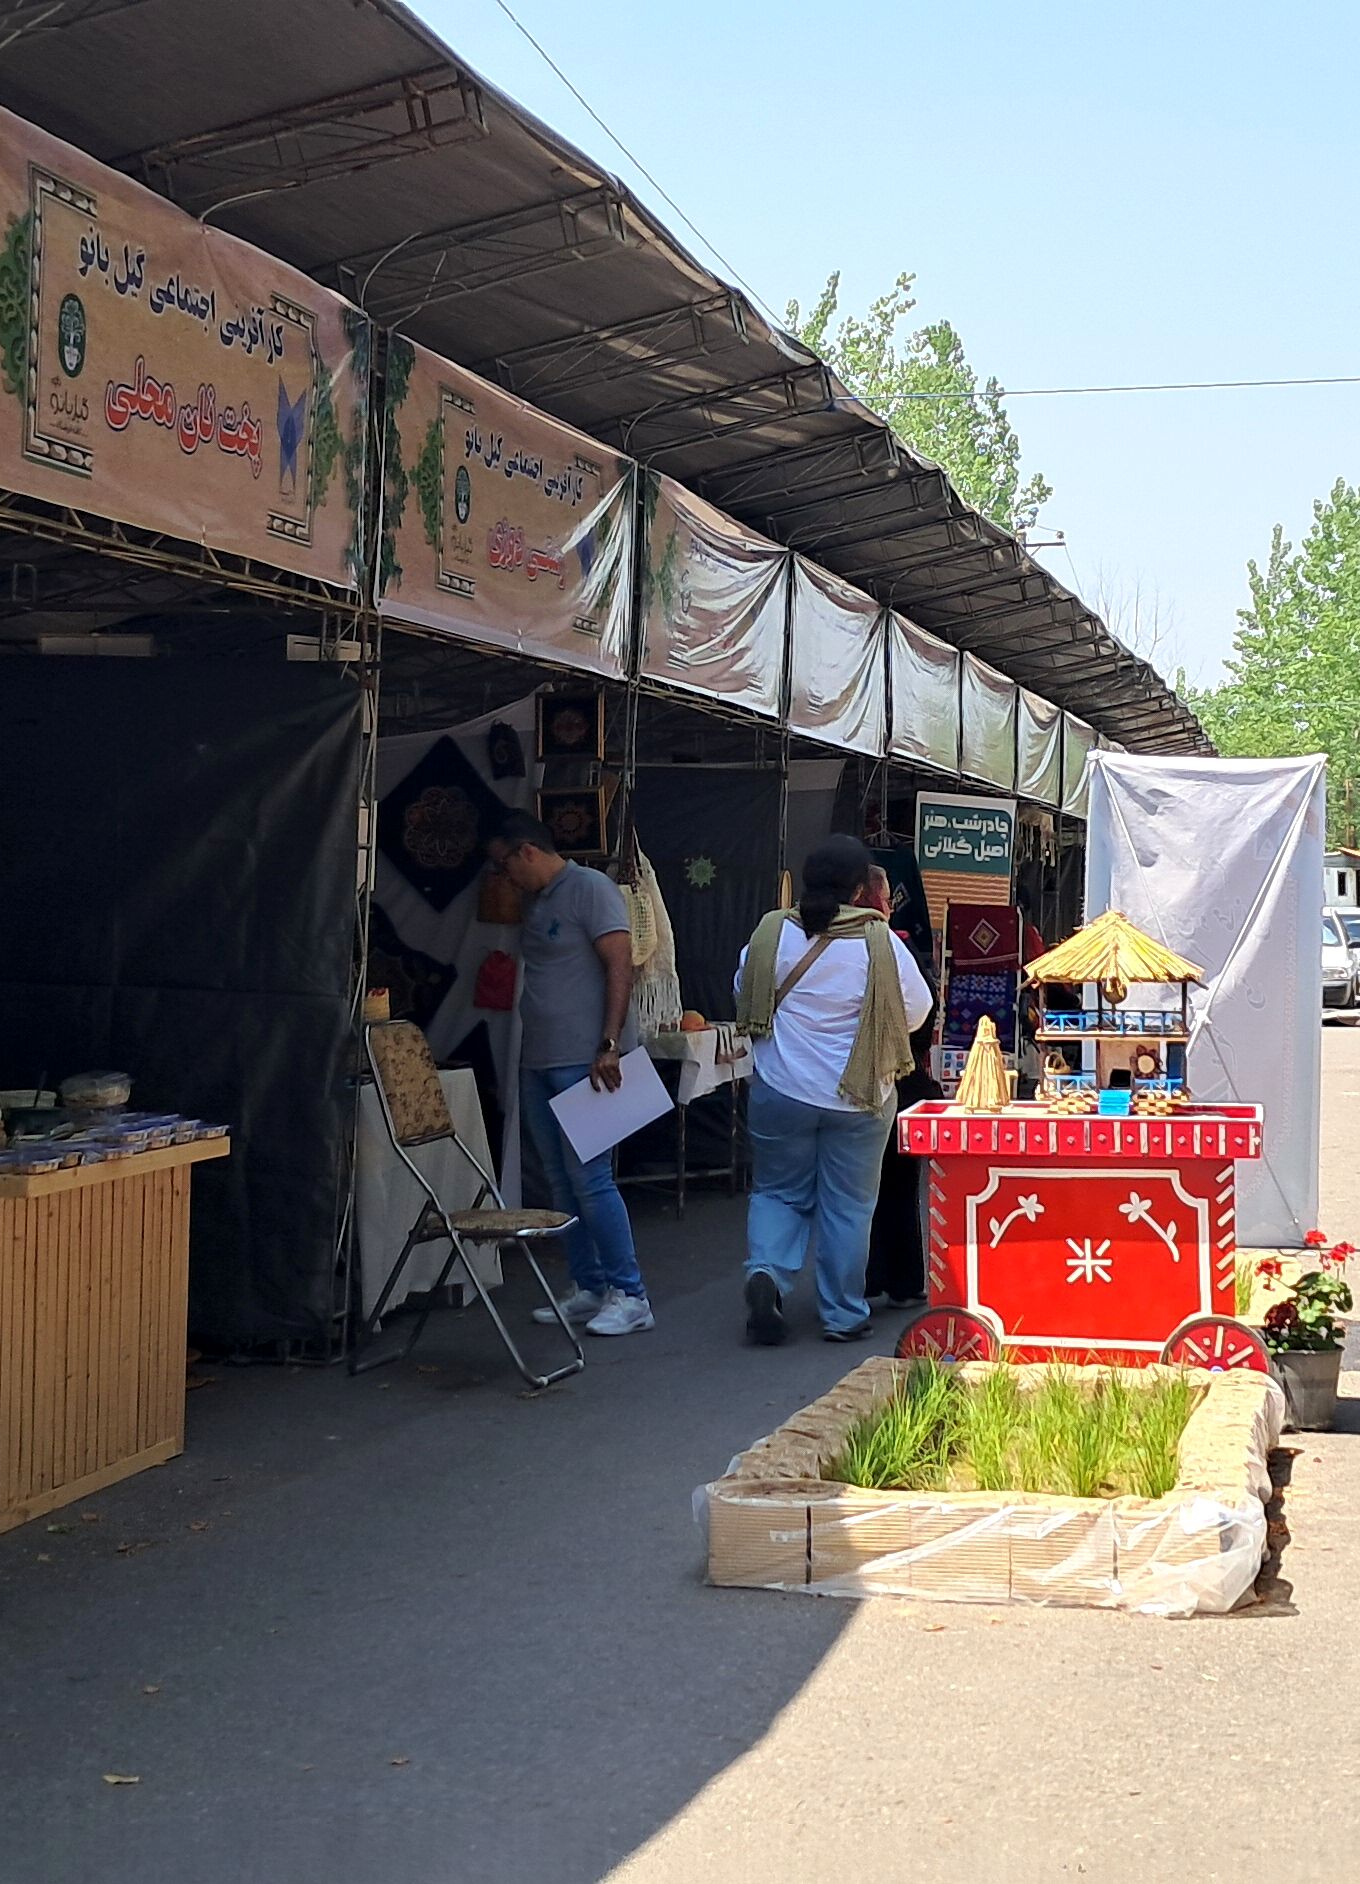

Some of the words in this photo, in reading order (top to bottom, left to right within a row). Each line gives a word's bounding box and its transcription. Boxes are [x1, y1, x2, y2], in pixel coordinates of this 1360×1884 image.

[77, 226, 112, 284] بانو
[113, 239, 147, 296] گیل
[149, 274, 216, 335] اجتماعی
[220, 305, 266, 357] آفرینی
[265, 322, 285, 365] کار
[105, 354, 177, 432] محلی
[177, 384, 216, 455] نان
[216, 401, 264, 480] پخت
[924, 834, 973, 859] گیلانی
[974, 840, 1009, 862] اصیل
